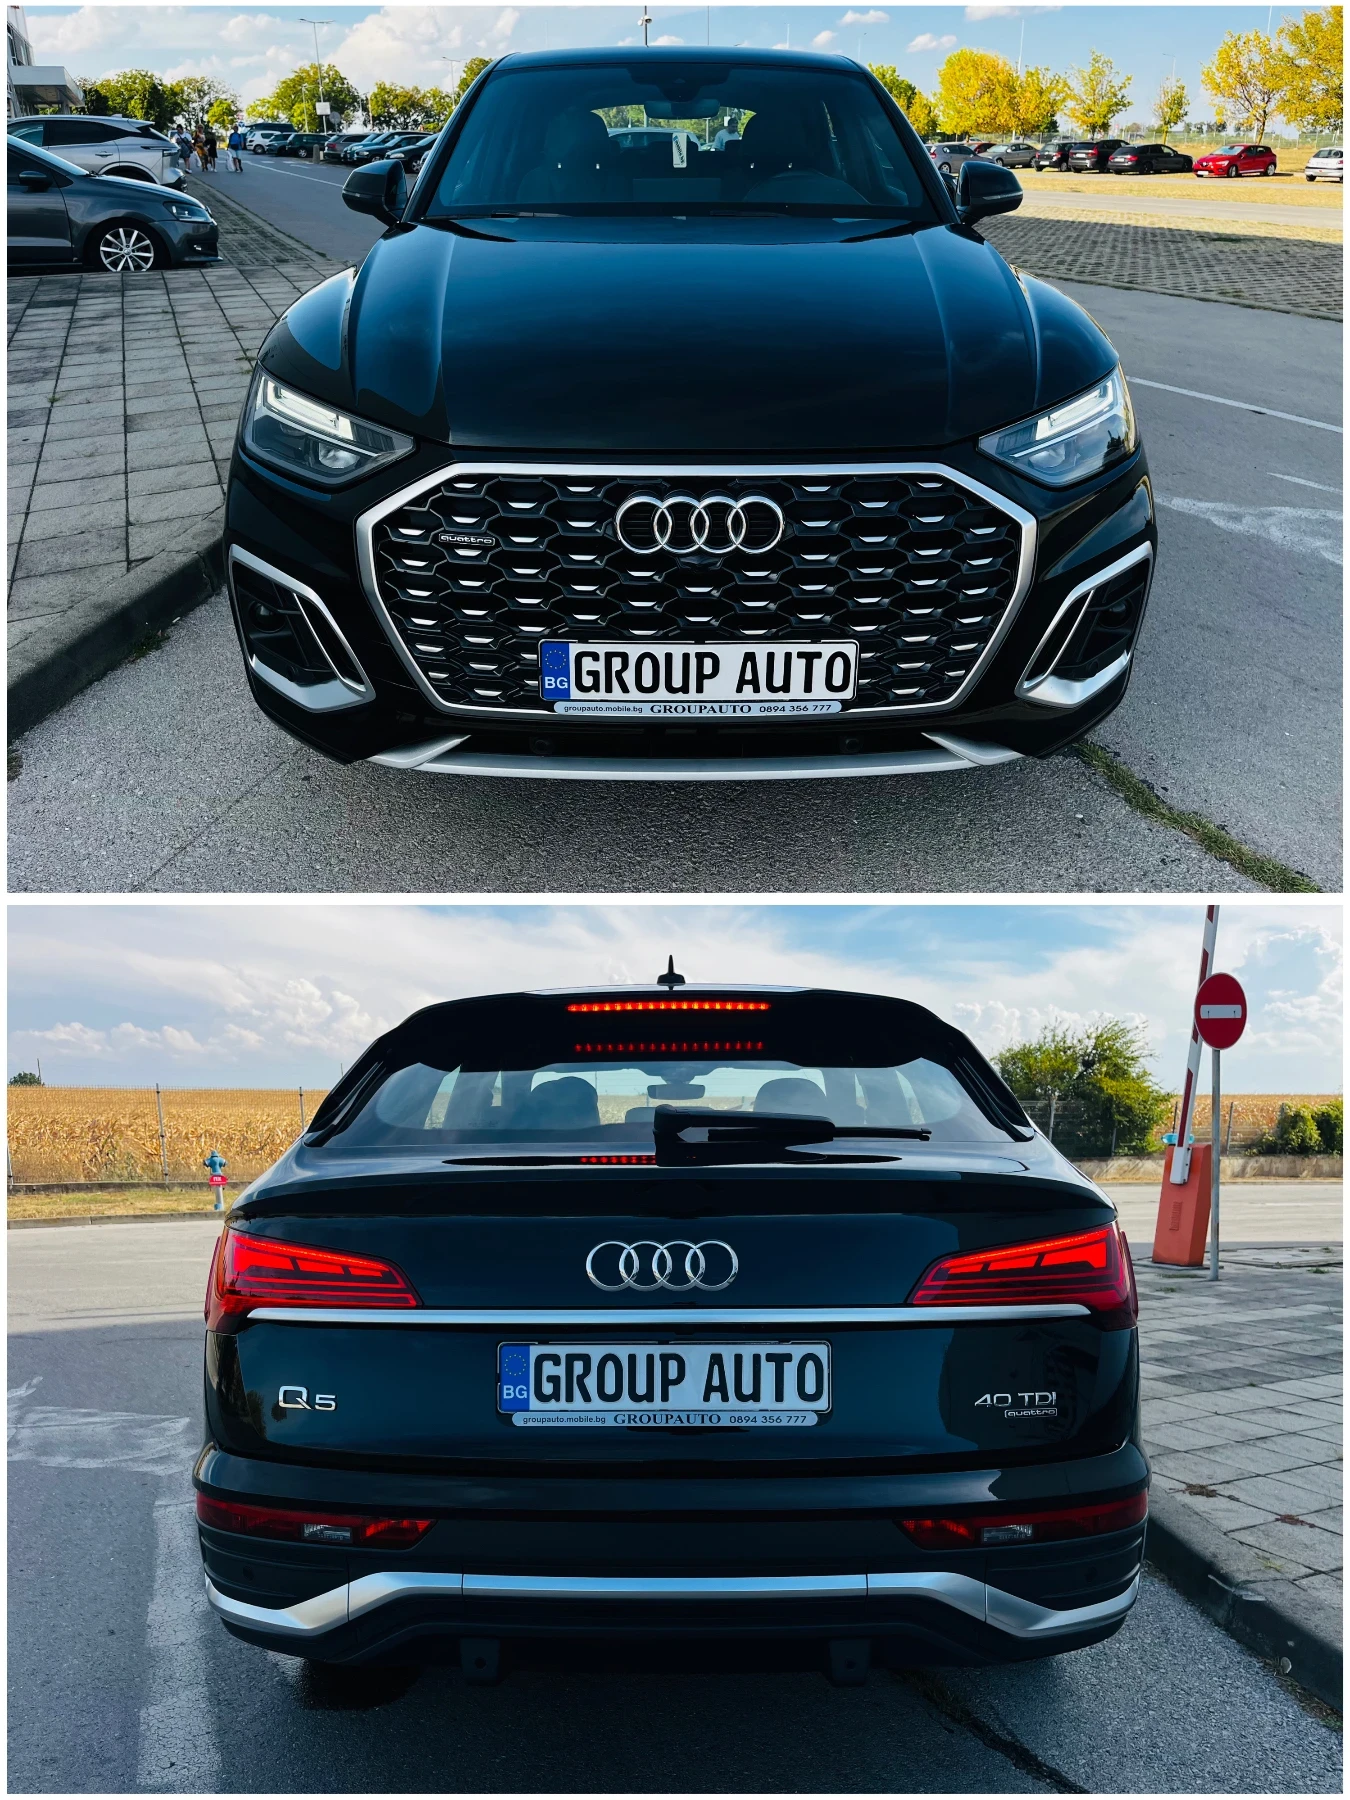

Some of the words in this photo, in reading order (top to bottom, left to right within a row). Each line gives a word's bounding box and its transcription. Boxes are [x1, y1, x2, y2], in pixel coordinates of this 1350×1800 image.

[441, 535, 493, 544] quattro
[574, 651, 720, 694] GROUP
[735, 651, 851, 694] AUTO
[544, 676, 569, 689] BG
[564, 705, 643, 713] groupauto.mobile.bg
[650, 704, 752, 714] GROUPAUTO
[759, 705, 786, 713] 0894
[812, 704, 832, 712] 777
[534, 1352, 686, 1403] GROUP
[702, 1352, 825, 1403] AUTO
[278, 1385, 337, 1411] Q5
[503, 1385, 528, 1400] BG
[974, 1393, 1012, 1407] 40
[1018, 1391, 1057, 1406] TDI
[523, 1416, 606, 1424] groupauto.mobile.bg
[613, 1413, 722, 1425] GROUPAUTO
[729, 1415, 758, 1424] 0894
[761, 1415, 783, 1424] 356
[786, 1415, 807, 1424] 777
[1007, 1409, 1056, 1418] quattro
